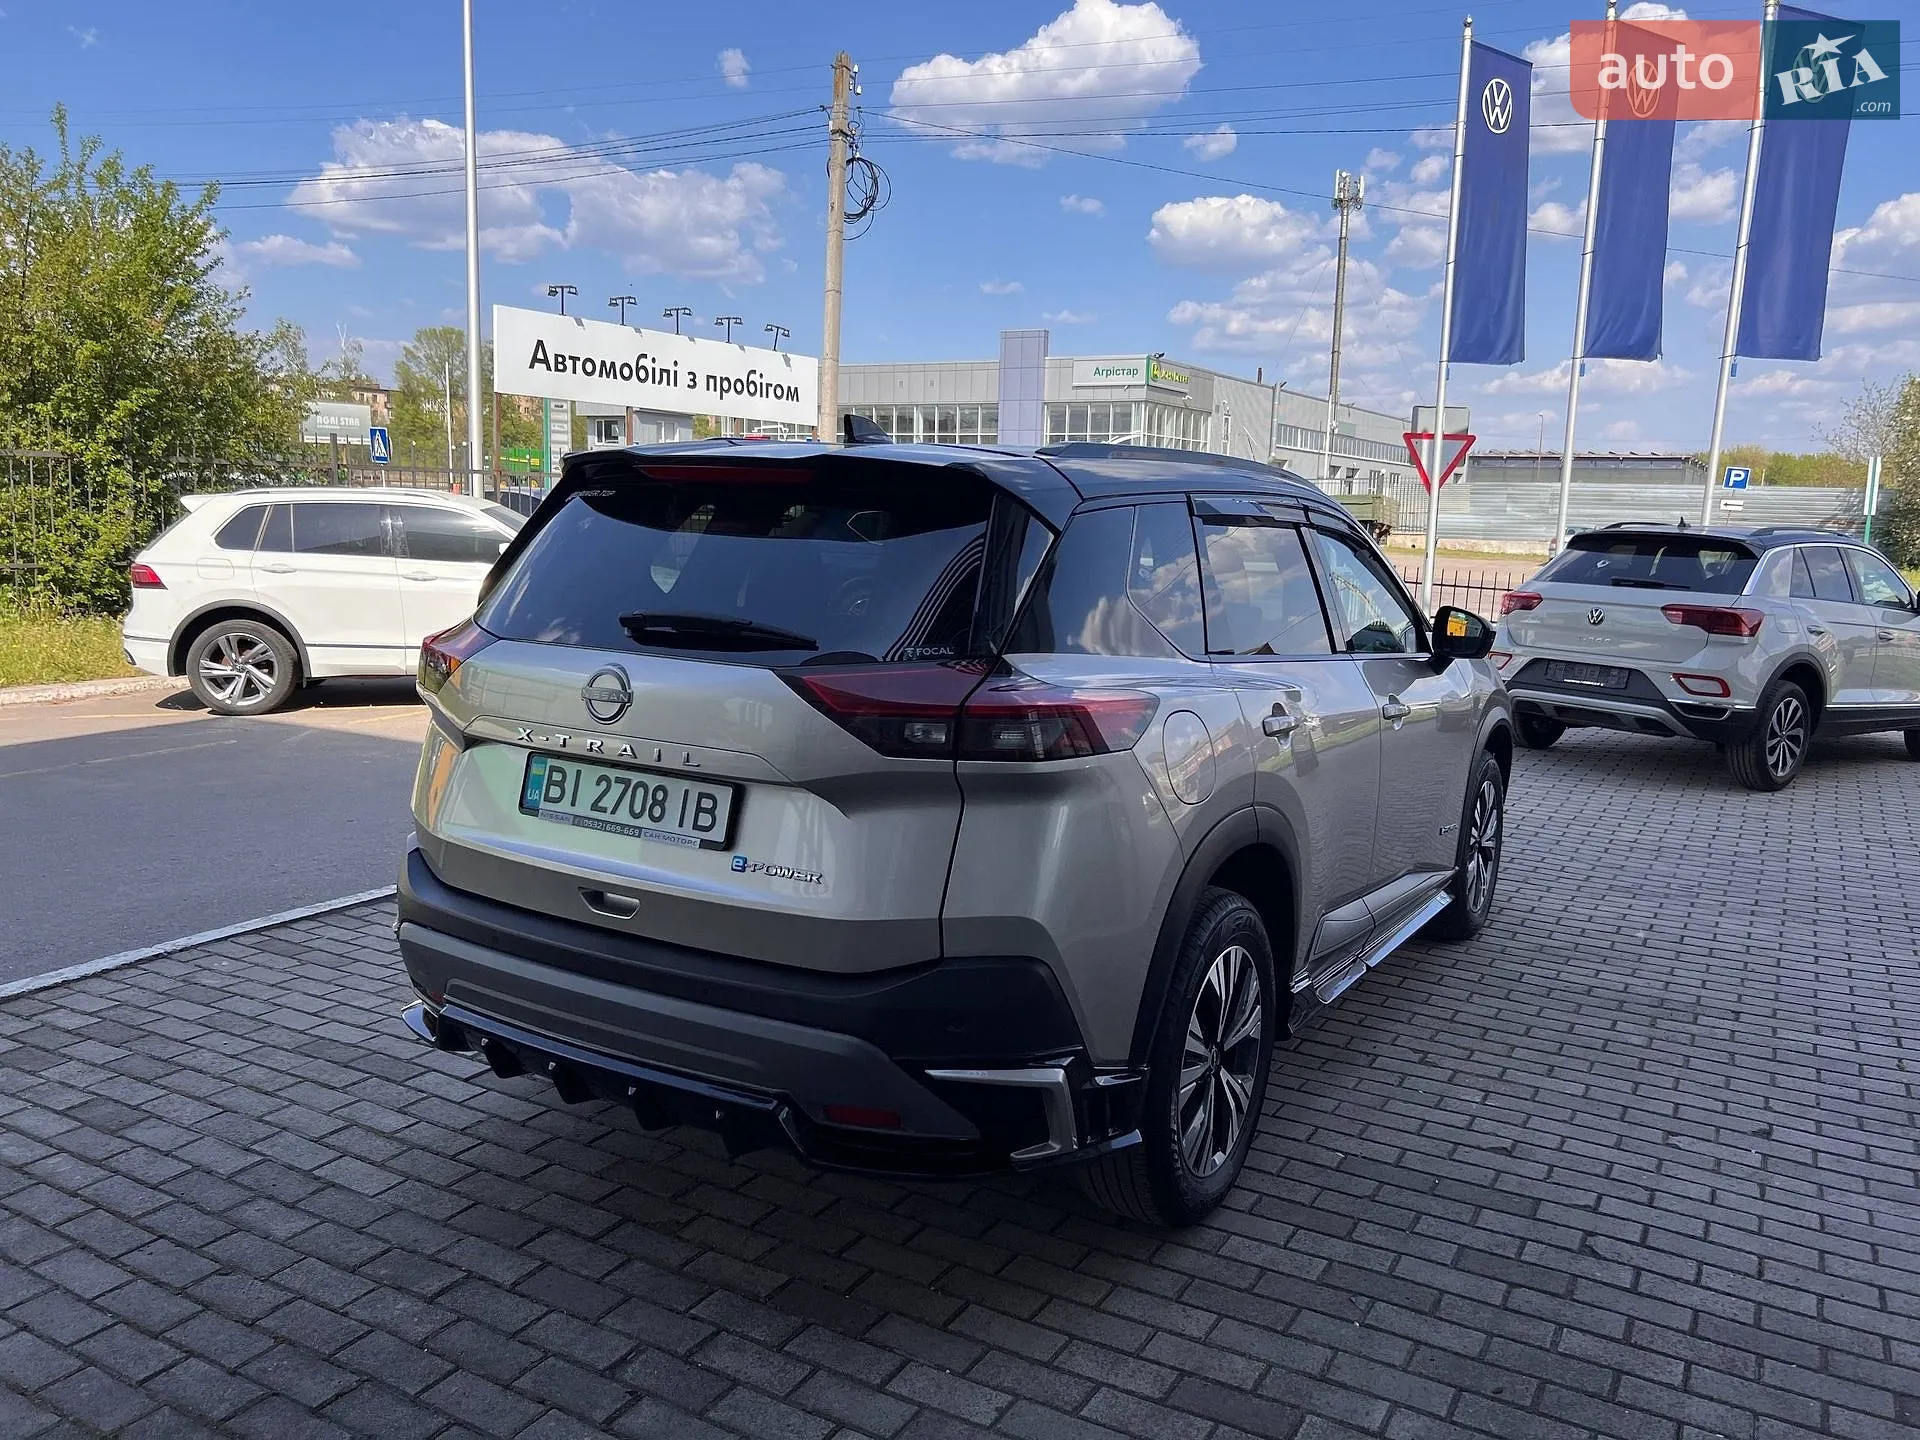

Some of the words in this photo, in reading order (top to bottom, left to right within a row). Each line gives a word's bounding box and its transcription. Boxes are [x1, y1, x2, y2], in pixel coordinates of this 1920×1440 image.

[528, 339, 679, 387] Автомобілі
[687, 371, 698, 390] з
[705, 369, 800, 403] пробігом
[1093, 366, 1139, 379] Агрістар
[1728, 469, 1746, 487] P
[916, 647, 955, 656] FOCAL
[517, 726, 702, 768] X-TRAIL
[527, 787, 540, 801] UA
[543, 764, 582, 808] BI
[589, 773, 669, 824] 2708
[677, 788, 718, 833] IB
